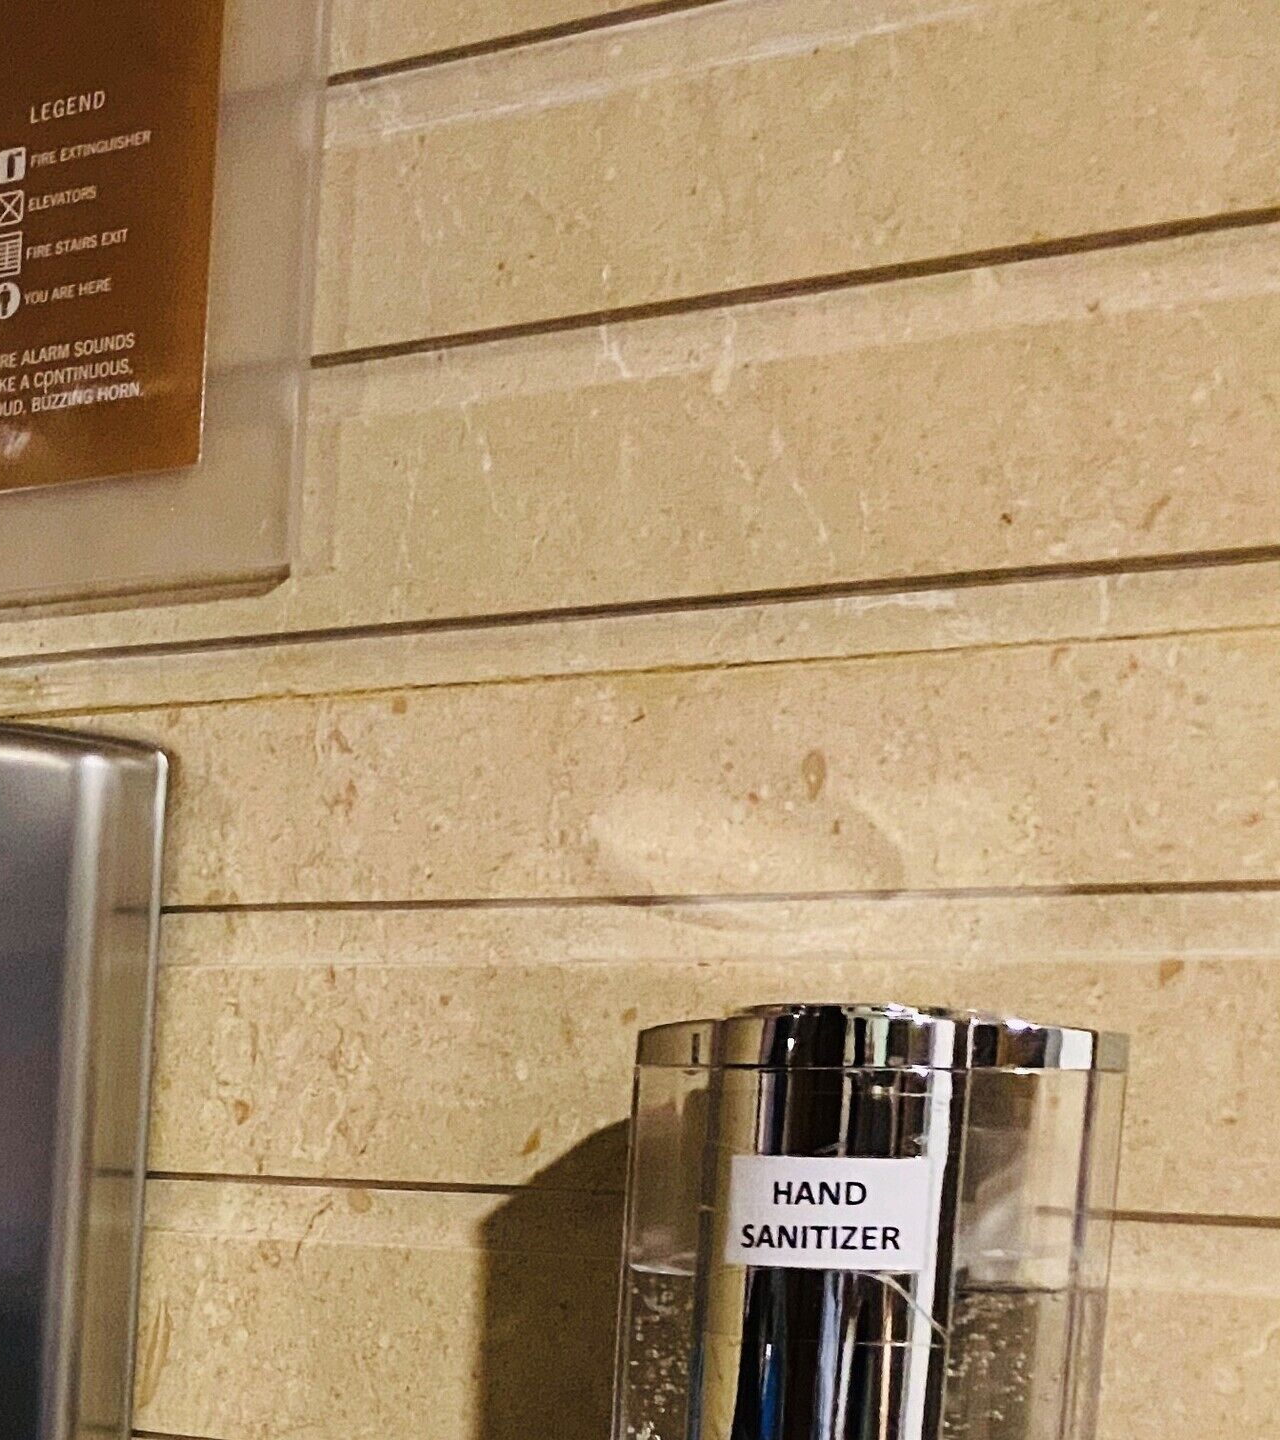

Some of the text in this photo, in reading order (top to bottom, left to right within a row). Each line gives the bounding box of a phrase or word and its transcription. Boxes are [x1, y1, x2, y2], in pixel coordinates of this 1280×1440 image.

[30, 90, 106, 124] LEGEND
[30, 130, 152, 168] FIRE EXTINGUISHER
[28, 184, 97, 212] ELEVATORS
[26, 228, 129, 260] FIRE STAIRS EXIT
[24, 277, 112, 305] YOU ARE HERE
[20, 343, 71, 366] ALARM
[73, 332, 137, 358] SOUNDS
[19, 374, 31, 390] A
[31, 387, 94, 413] BUZZING
[96, 381, 145, 402] HORN.
[773, 1181, 868, 1206] HAND
[740, 1224, 901, 1250] SANITIZER
